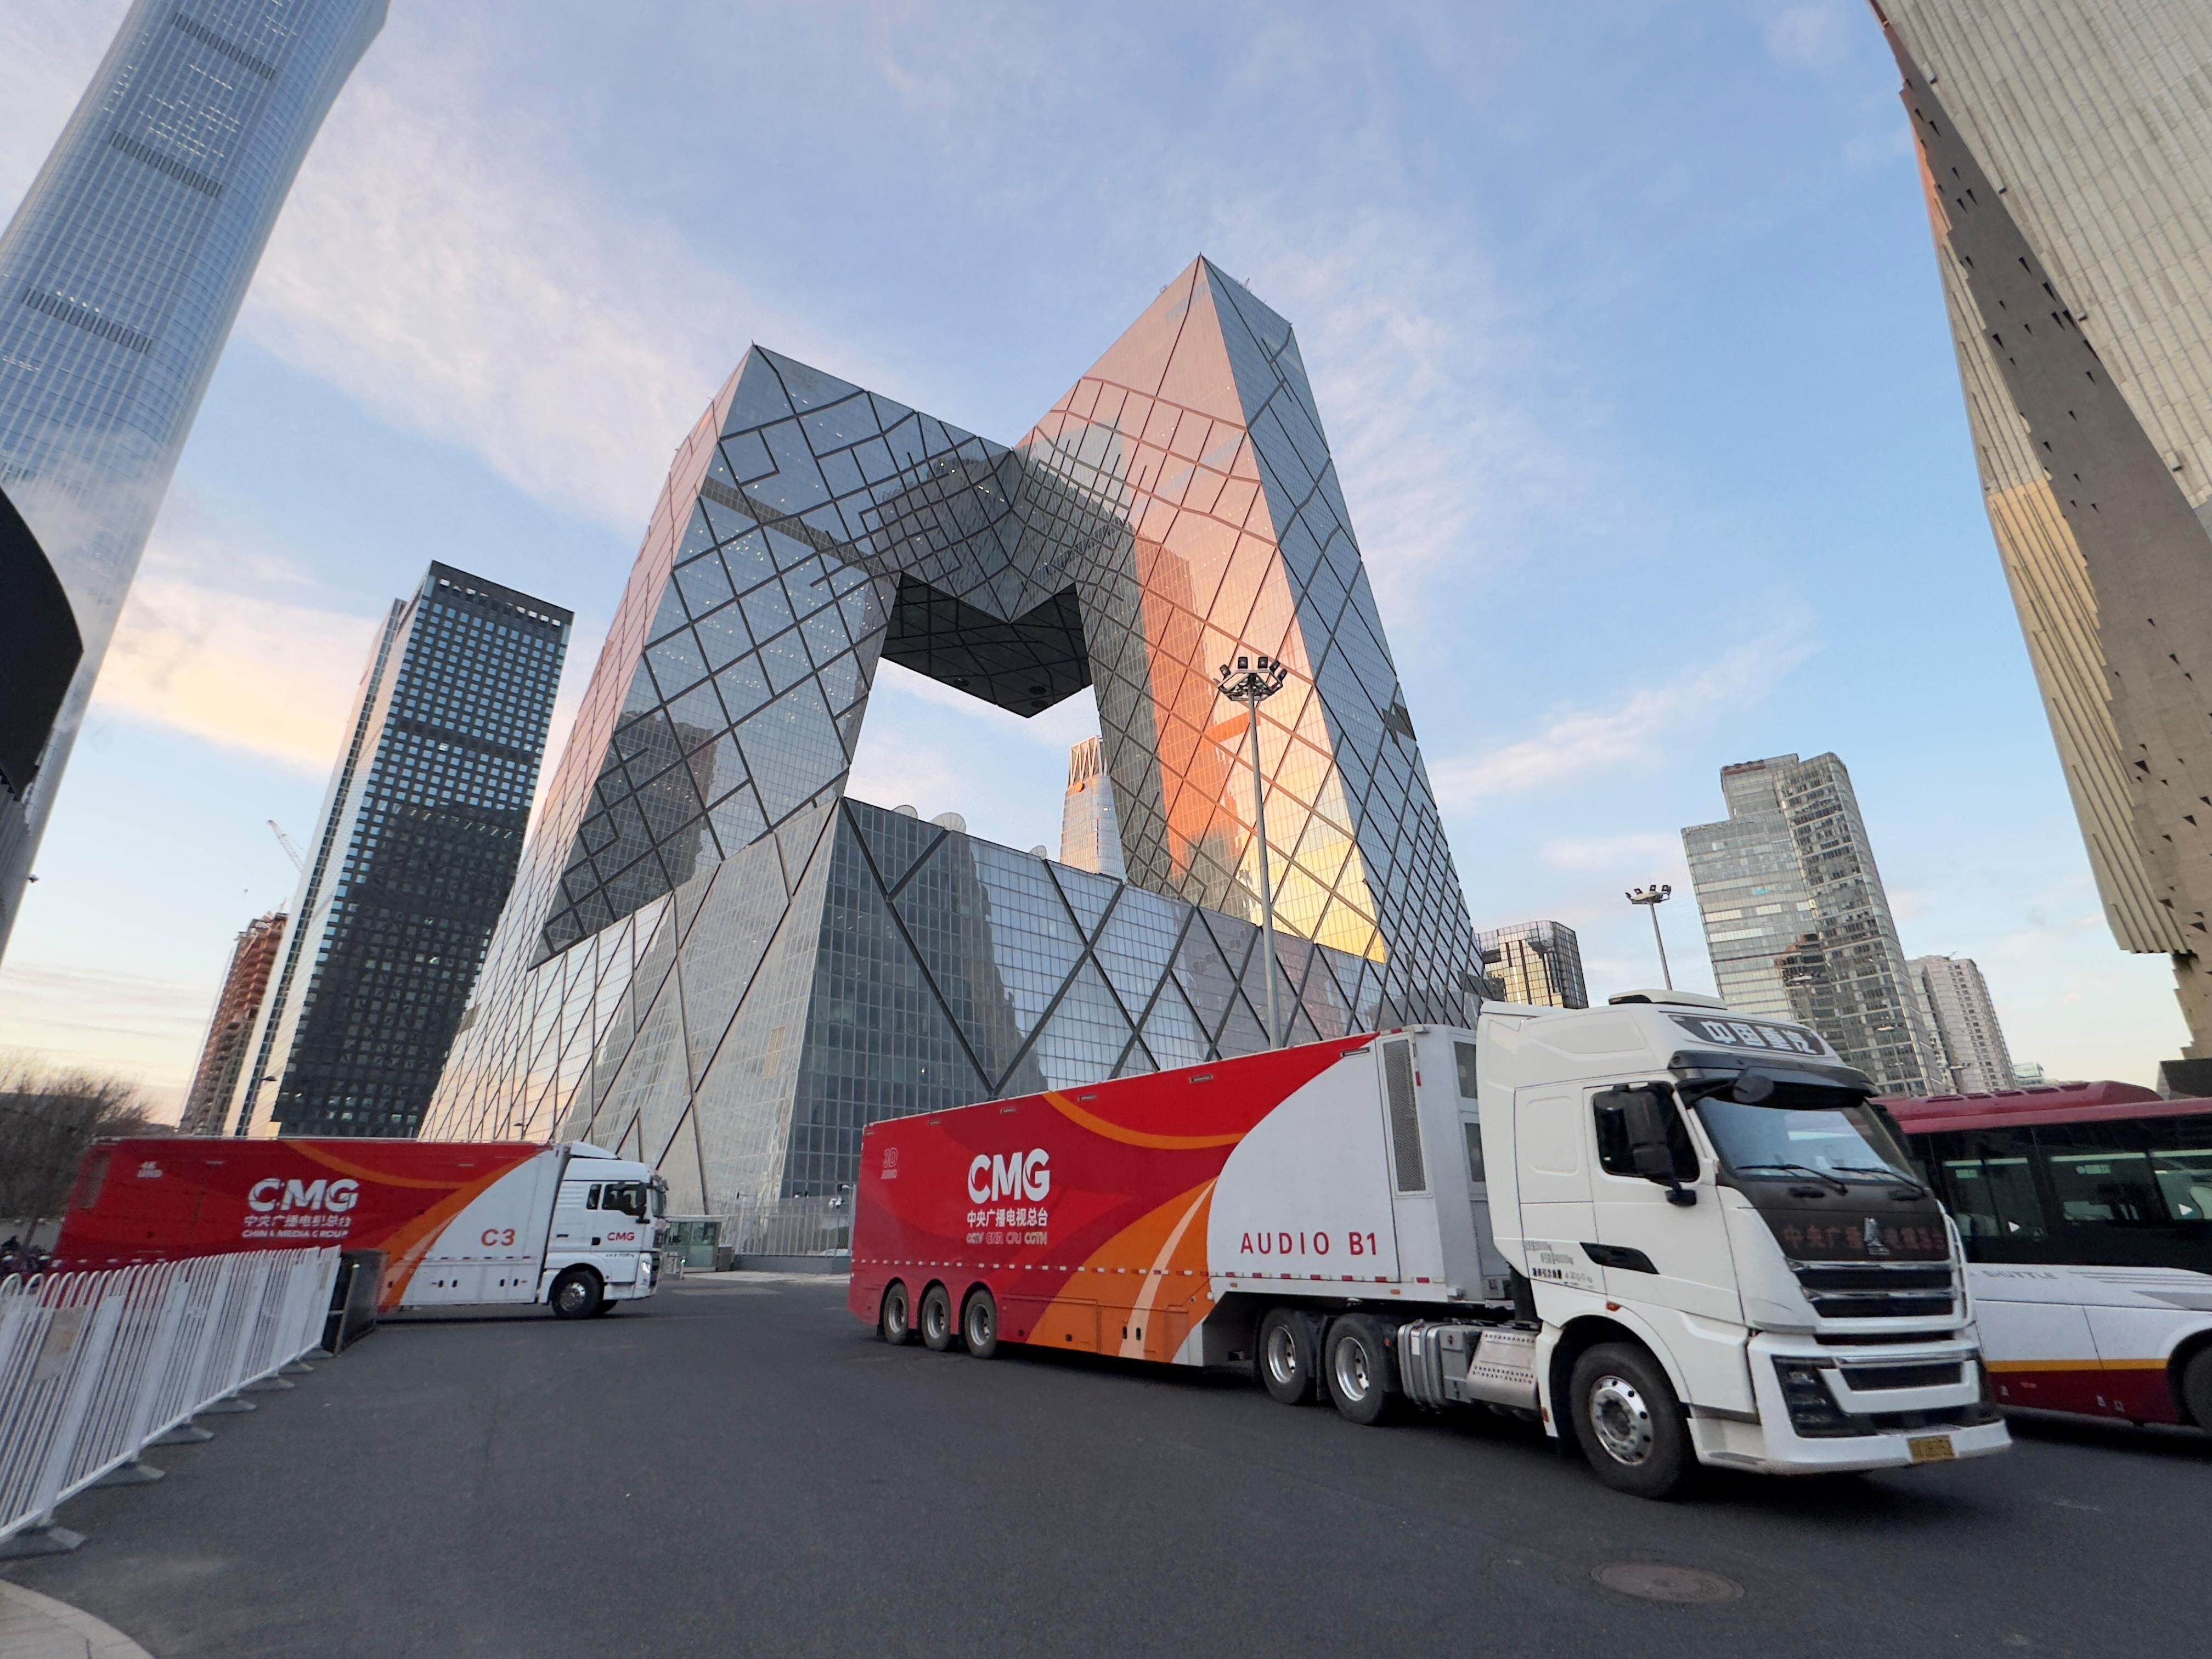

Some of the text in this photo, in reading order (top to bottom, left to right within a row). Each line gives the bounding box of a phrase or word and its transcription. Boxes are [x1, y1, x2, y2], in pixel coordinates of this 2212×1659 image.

[1700, 1020, 1818, 1054] 中国重汽
[968, 1148, 1049, 1204] CMG
[248, 1178, 359, 1212] CMG
[967, 1207, 1048, 1228] 中央广播电视总台
[276, 1229, 309, 1238] MEDIA
[481, 1229, 515, 1246] C3
[607, 1232, 635, 1241] CMG
[1024, 1232, 1048, 1245] CGTN
[1240, 1232, 1376, 1255] AUDIO B1
